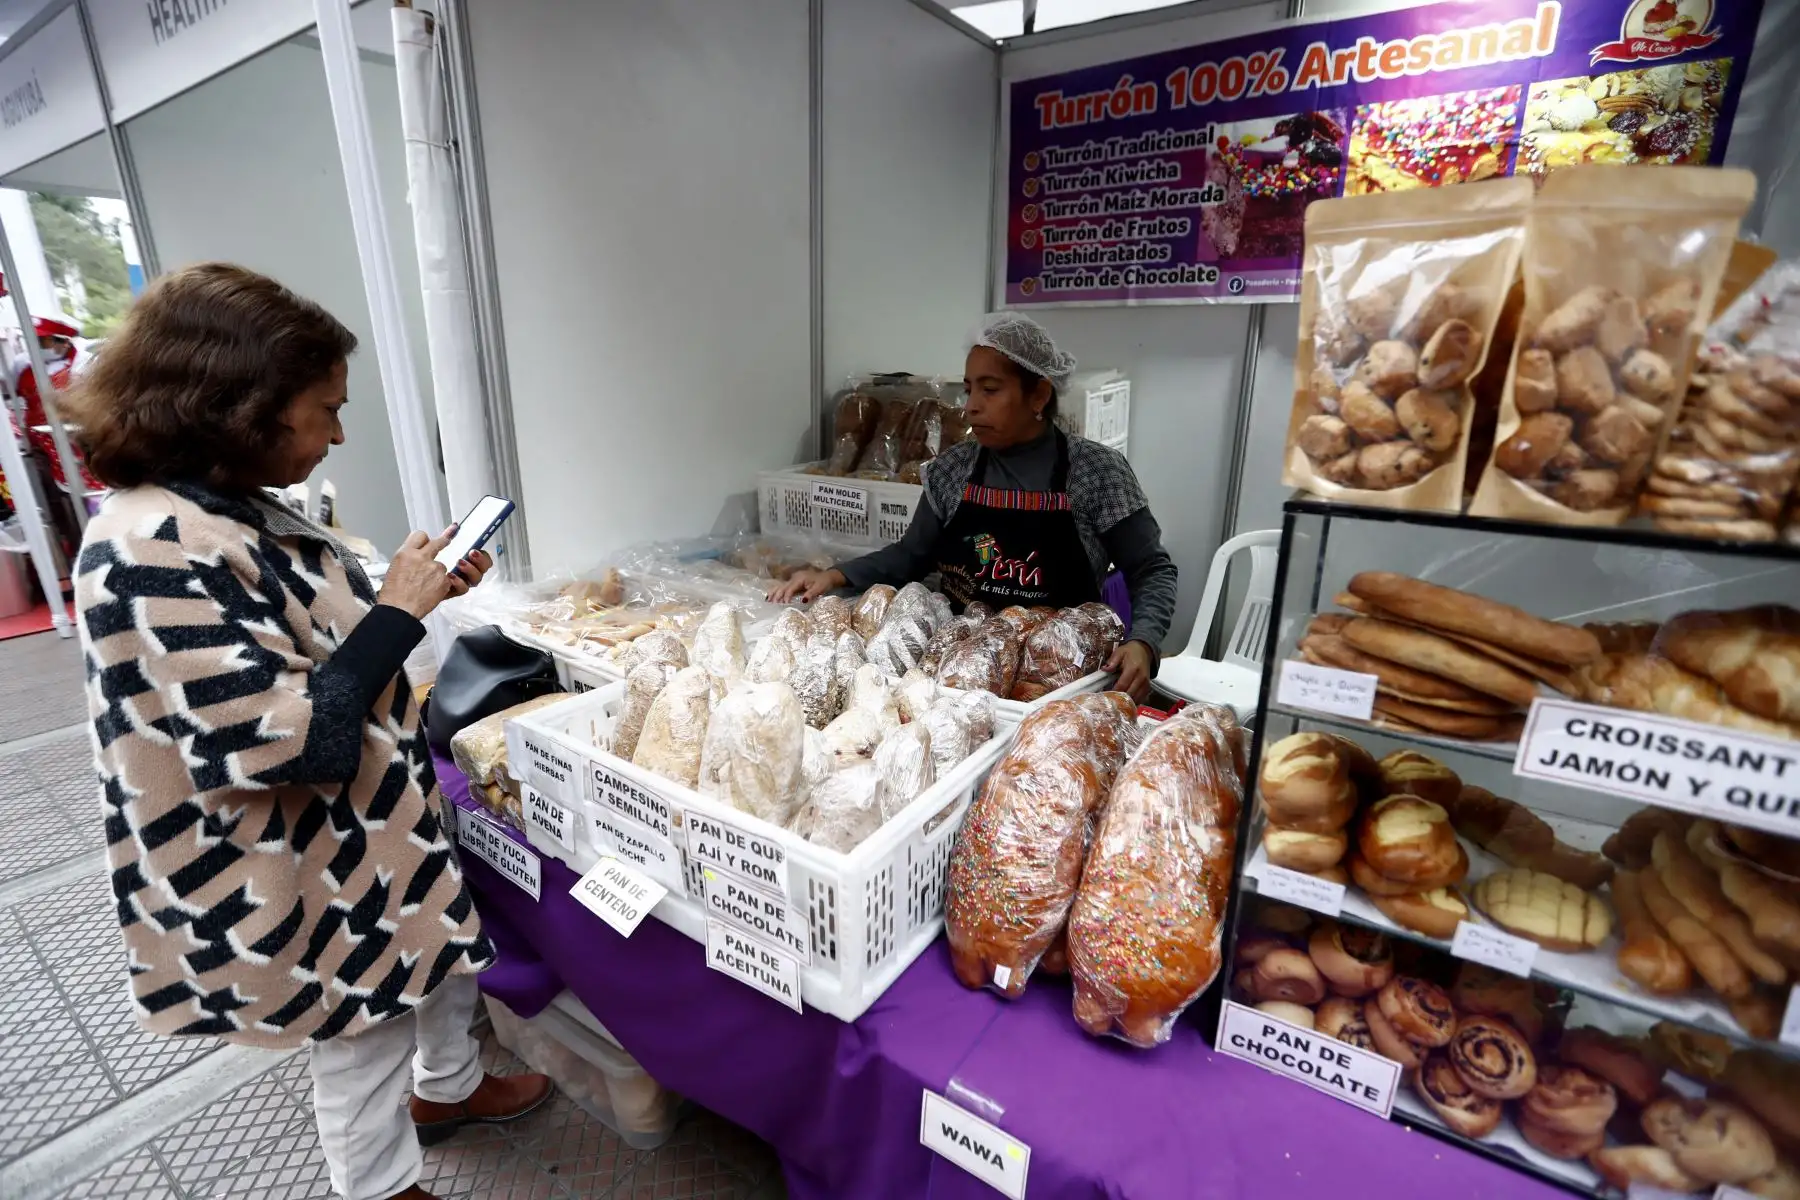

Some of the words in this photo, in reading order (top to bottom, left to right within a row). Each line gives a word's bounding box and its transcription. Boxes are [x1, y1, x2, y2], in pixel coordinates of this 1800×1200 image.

[1035, 74, 1157, 131] Turrón
[1166, 47, 1290, 110] 100%
[1290, 1, 1561, 92] Artesanal
[1045, 140, 1103, 166] Turrón
[1107, 124, 1215, 159] Tradicional
[1044, 172, 1100, 193] Turrón
[1105, 161, 1180, 186] Kiwicha
[1043, 198, 1101, 217] Turrón
[1104, 191, 1145, 211] Maíz
[1150, 185, 1225, 207] Morada
[1042, 221, 1098, 243] Turrón
[1102, 222, 1123, 239] de
[1127, 218, 1189, 237] Frutos
[1044, 244, 1169, 266] Deshidratados
[1041, 269, 1094, 289] Turrón
[1098, 269, 1120, 287] de
[1123, 265, 1218, 285] Chocolate
[813, 495, 864, 511] MULTICEREAL
[818, 485, 834, 495] PAN
[836, 488, 861, 500] MOLDE
[980, 581, 990, 592] de
[992, 585, 1010, 596] mis
[525, 741, 539, 756] PAN
[540, 751, 550, 762] DE
[551, 756, 573, 773] FINAS
[1565, 718, 1797, 778] CROISSANT
[534, 760, 565, 782] HIERBAS
[1539, 749, 1672, 791] JAMÓN
[1687, 776, 1712, 798] Y
[529, 792, 549, 813] PAN
[551, 807, 564, 824] DE
[595, 769, 668, 819] CAMPESINO
[596, 787, 604, 799] 7
[608, 792, 668, 837] SEMILLAS
[470, 821, 487, 839] PAN
[488, 833, 500, 848] DE
[502, 842, 527, 867] YUCA
[532, 811, 563, 840] AVENA
[595, 820, 613, 834] PAN
[614, 829, 625, 841] DE
[626, 836, 666, 862] ZAPALLO
[690, 818, 721, 840] PAN
[725, 831, 746, 850] DE
[750, 841, 785, 864] QUE
[462, 830, 486, 853] LIBRE
[487, 847, 499, 862] DE
[500, 857, 536, 889] GLUTEN
[618, 844, 646, 865] LOCHE
[697, 842, 721, 861] AJÍ
[726, 852, 735, 867] Y
[741, 859, 781, 887] ROM
[584, 879, 638, 921] CENTENO
[604, 867, 631, 889] PAN
[628, 883, 648, 901] DE
[727, 884, 759, 910] PAN
[764, 902, 786, 923] DE
[711, 894, 804, 954] CHOCOLATE
[715, 948, 792, 998] ACEITUNA
[725, 934, 756, 959] PAN
[760, 951, 780, 972] DE
[1230, 1034, 1380, 1102] CHOCOLATE
[1261, 1024, 1310, 1053] PAN
[1319, 1046, 1352, 1070] DE
[941, 1122, 1005, 1171] WAWA
